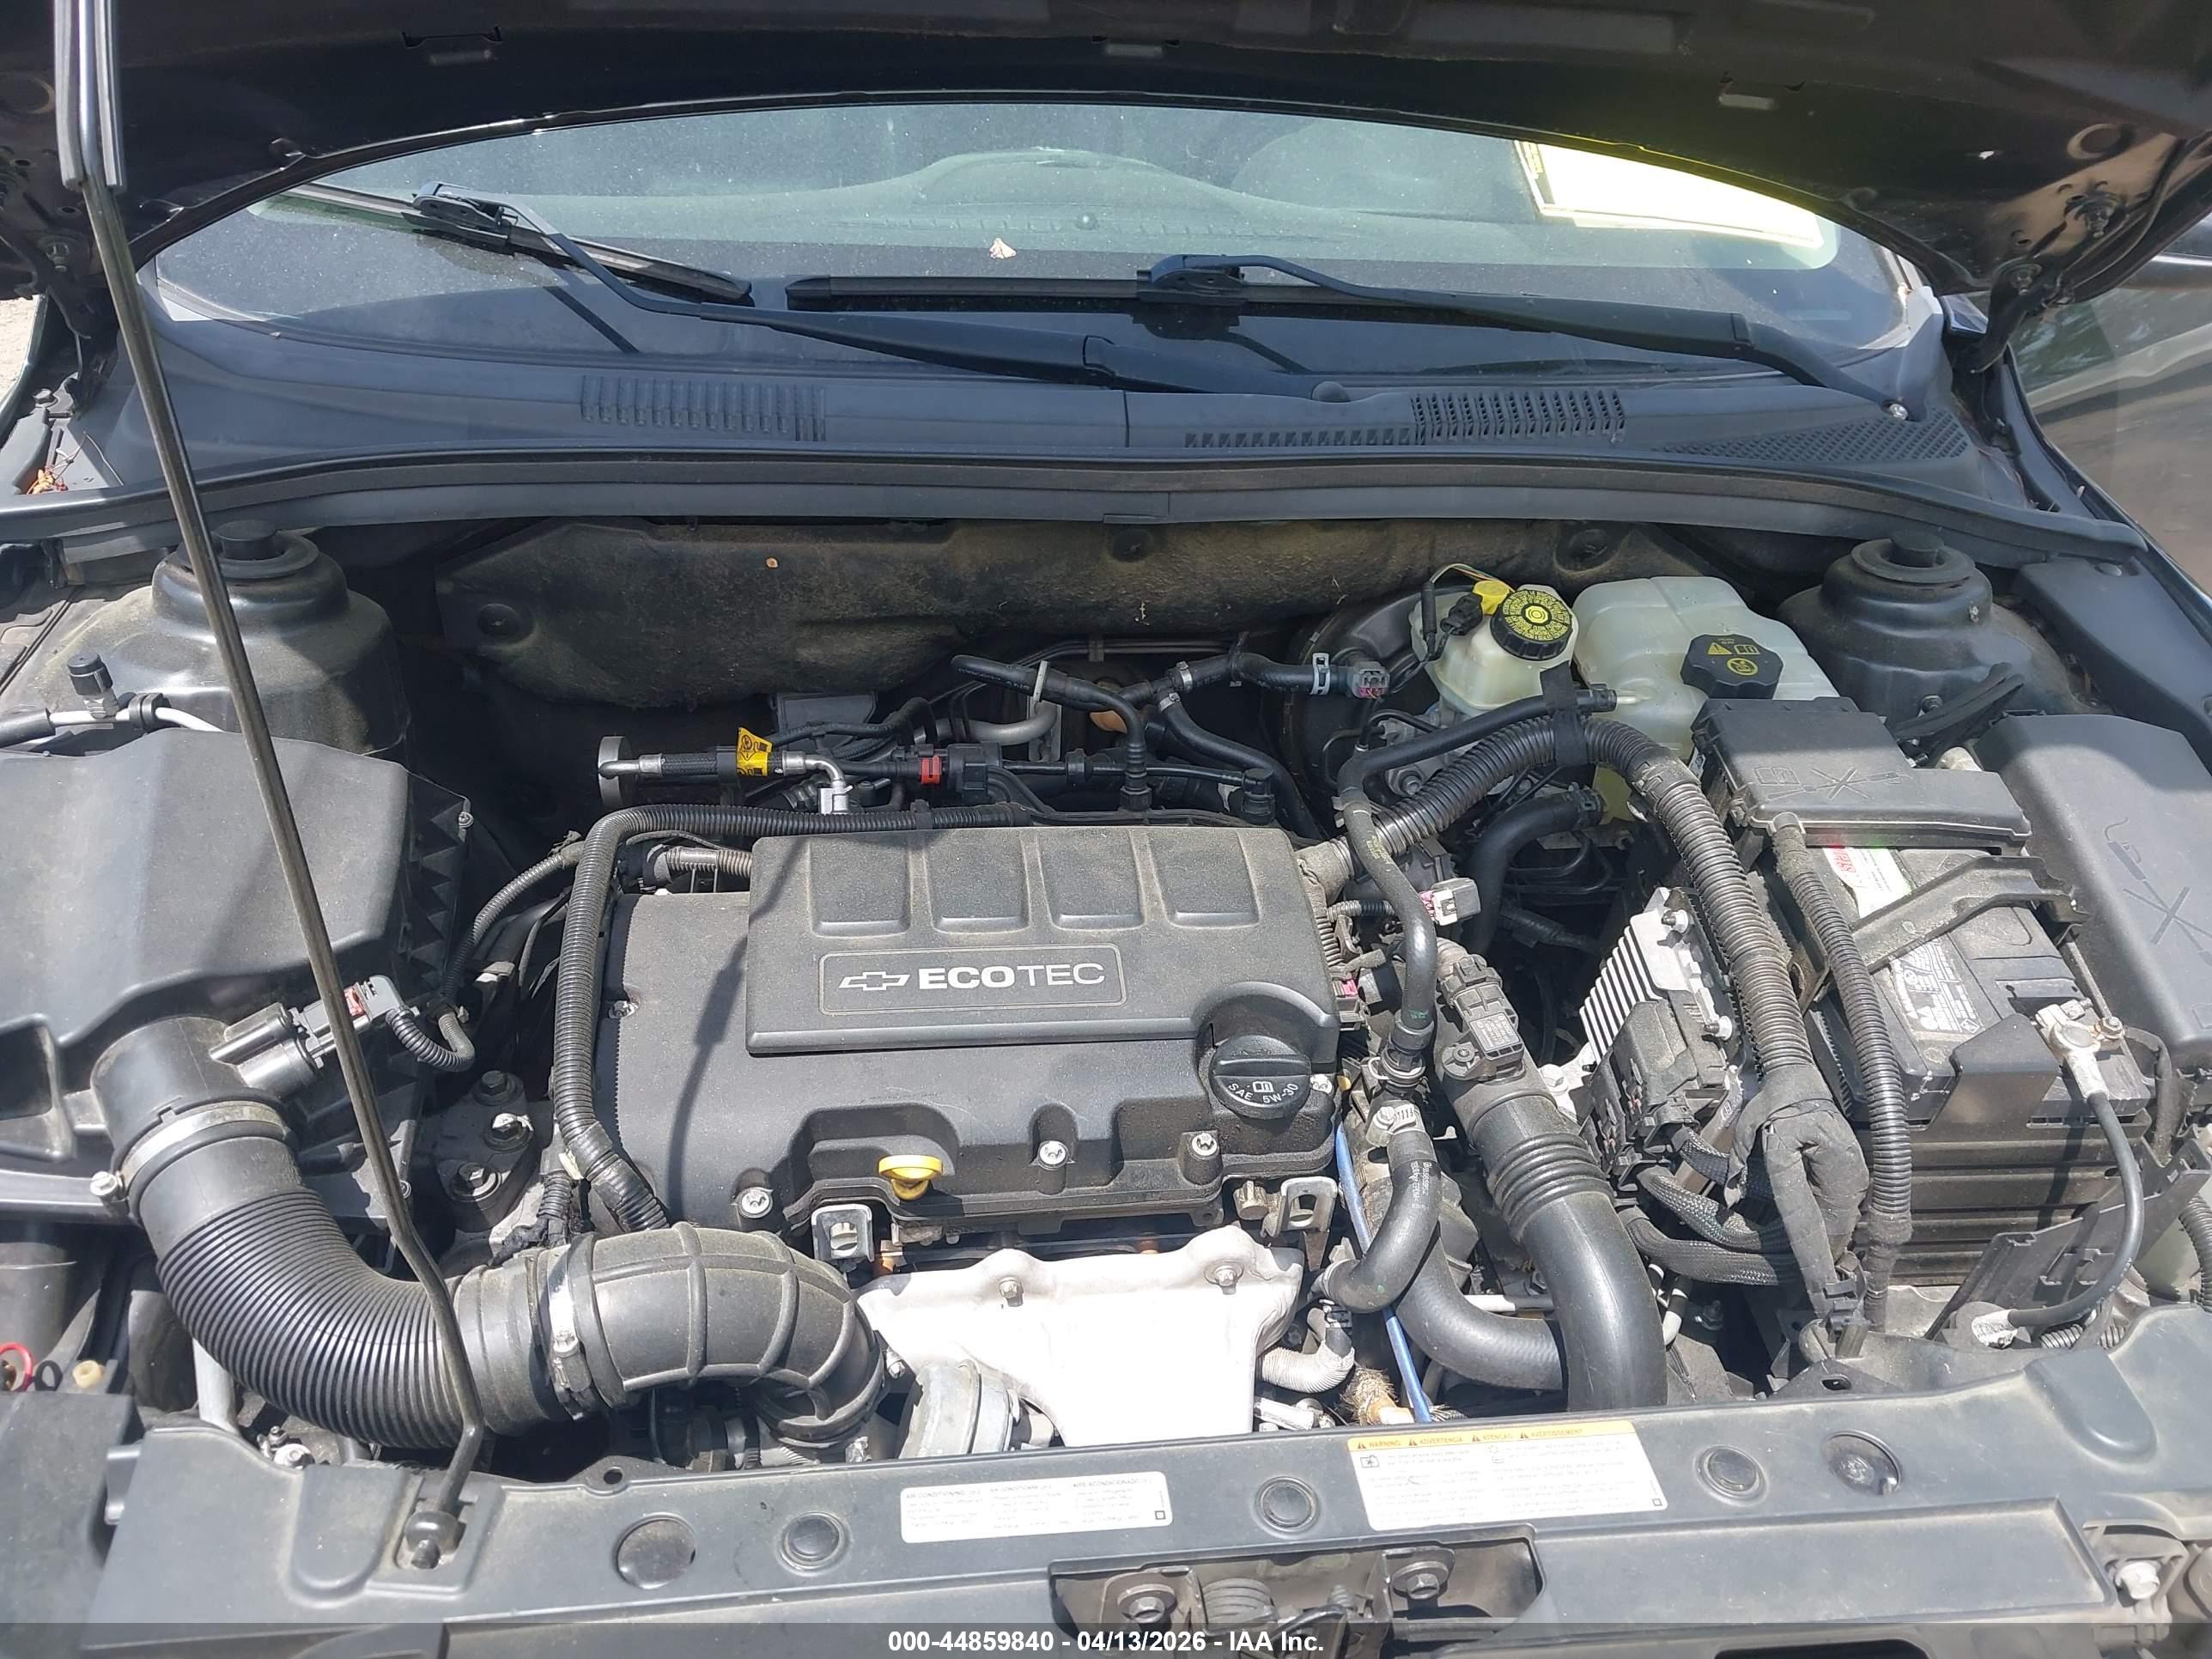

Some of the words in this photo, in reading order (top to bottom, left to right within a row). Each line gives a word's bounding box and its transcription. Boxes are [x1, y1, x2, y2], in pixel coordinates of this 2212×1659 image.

[919, 963, 1105, 989] ECOTEC
[1228, 1083, 1253, 1101] SAE
[1262, 1083, 1298, 1103] 5W-30
